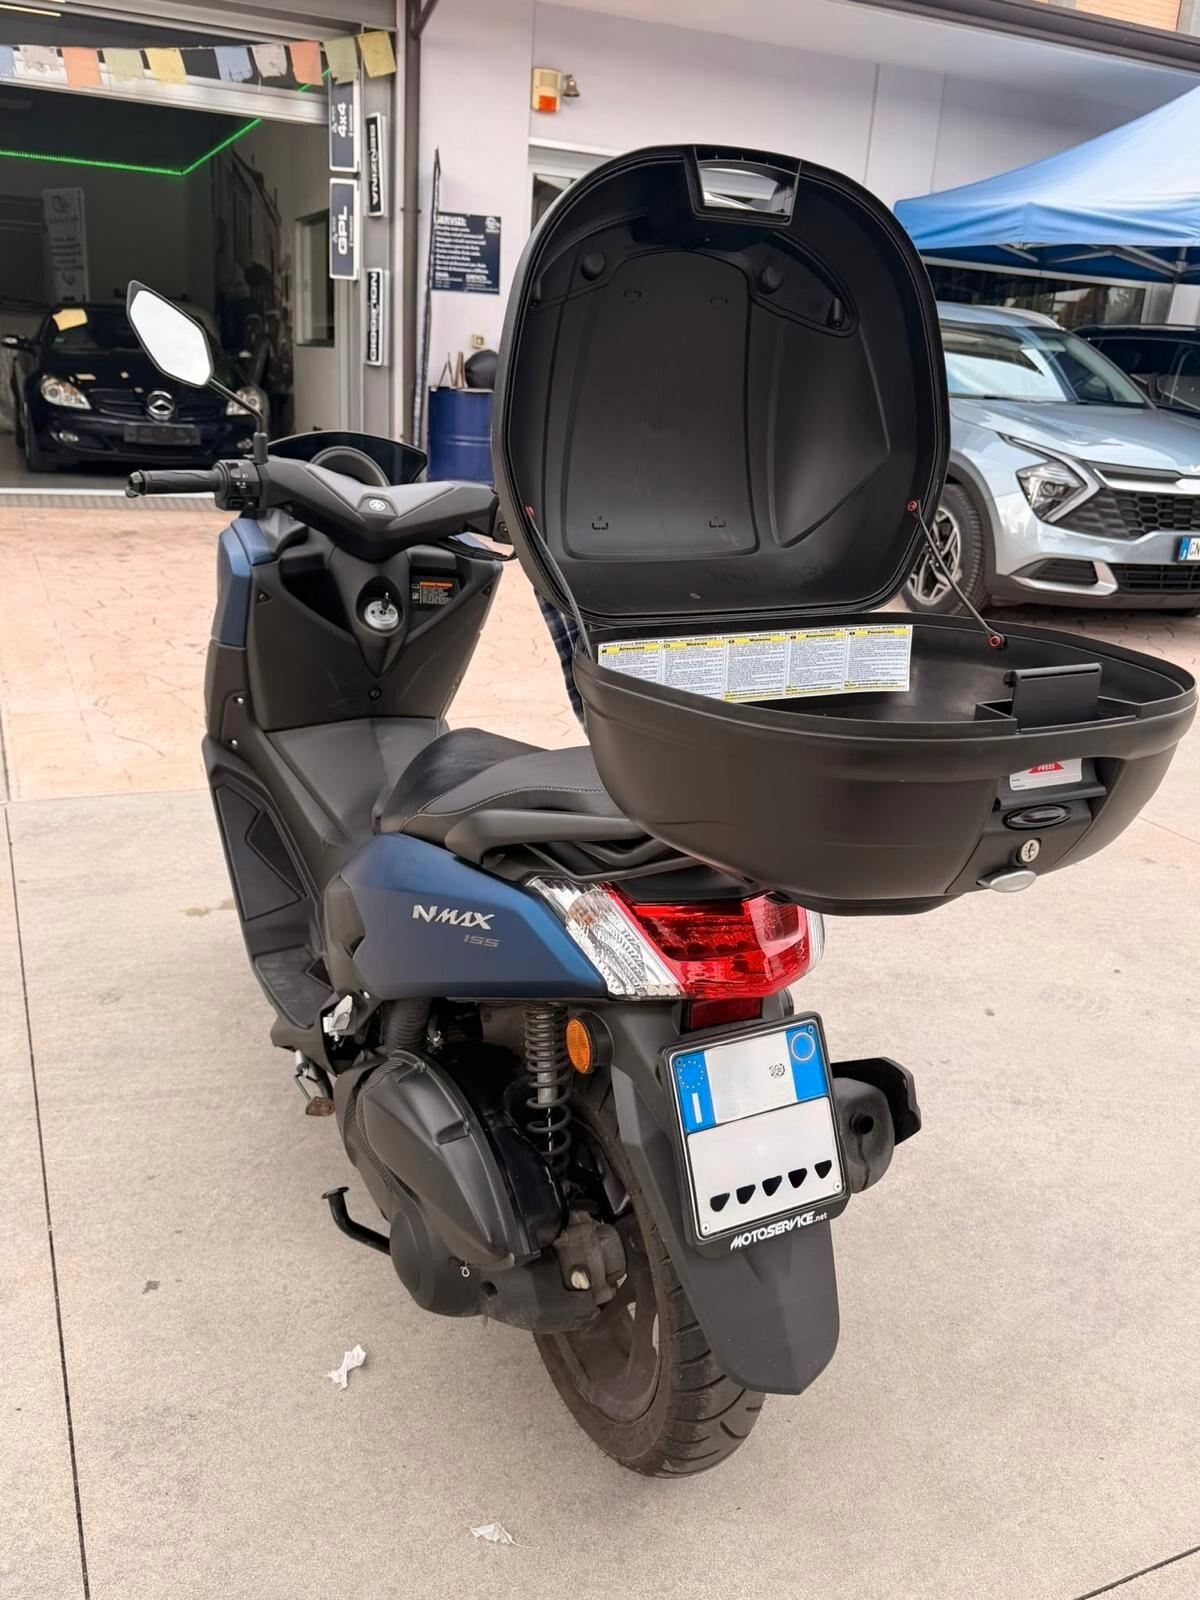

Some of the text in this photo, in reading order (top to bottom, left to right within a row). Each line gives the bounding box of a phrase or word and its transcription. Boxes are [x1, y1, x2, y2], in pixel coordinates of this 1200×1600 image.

[337, 102, 347, 138] 4x4
[369, 124, 379, 205] BENZINA
[337, 205, 348, 255] GPL
[1037, 763, 1055, 772] PRESS
[412, 904, 495, 930] NMAX
[463, 934, 501, 948] 155
